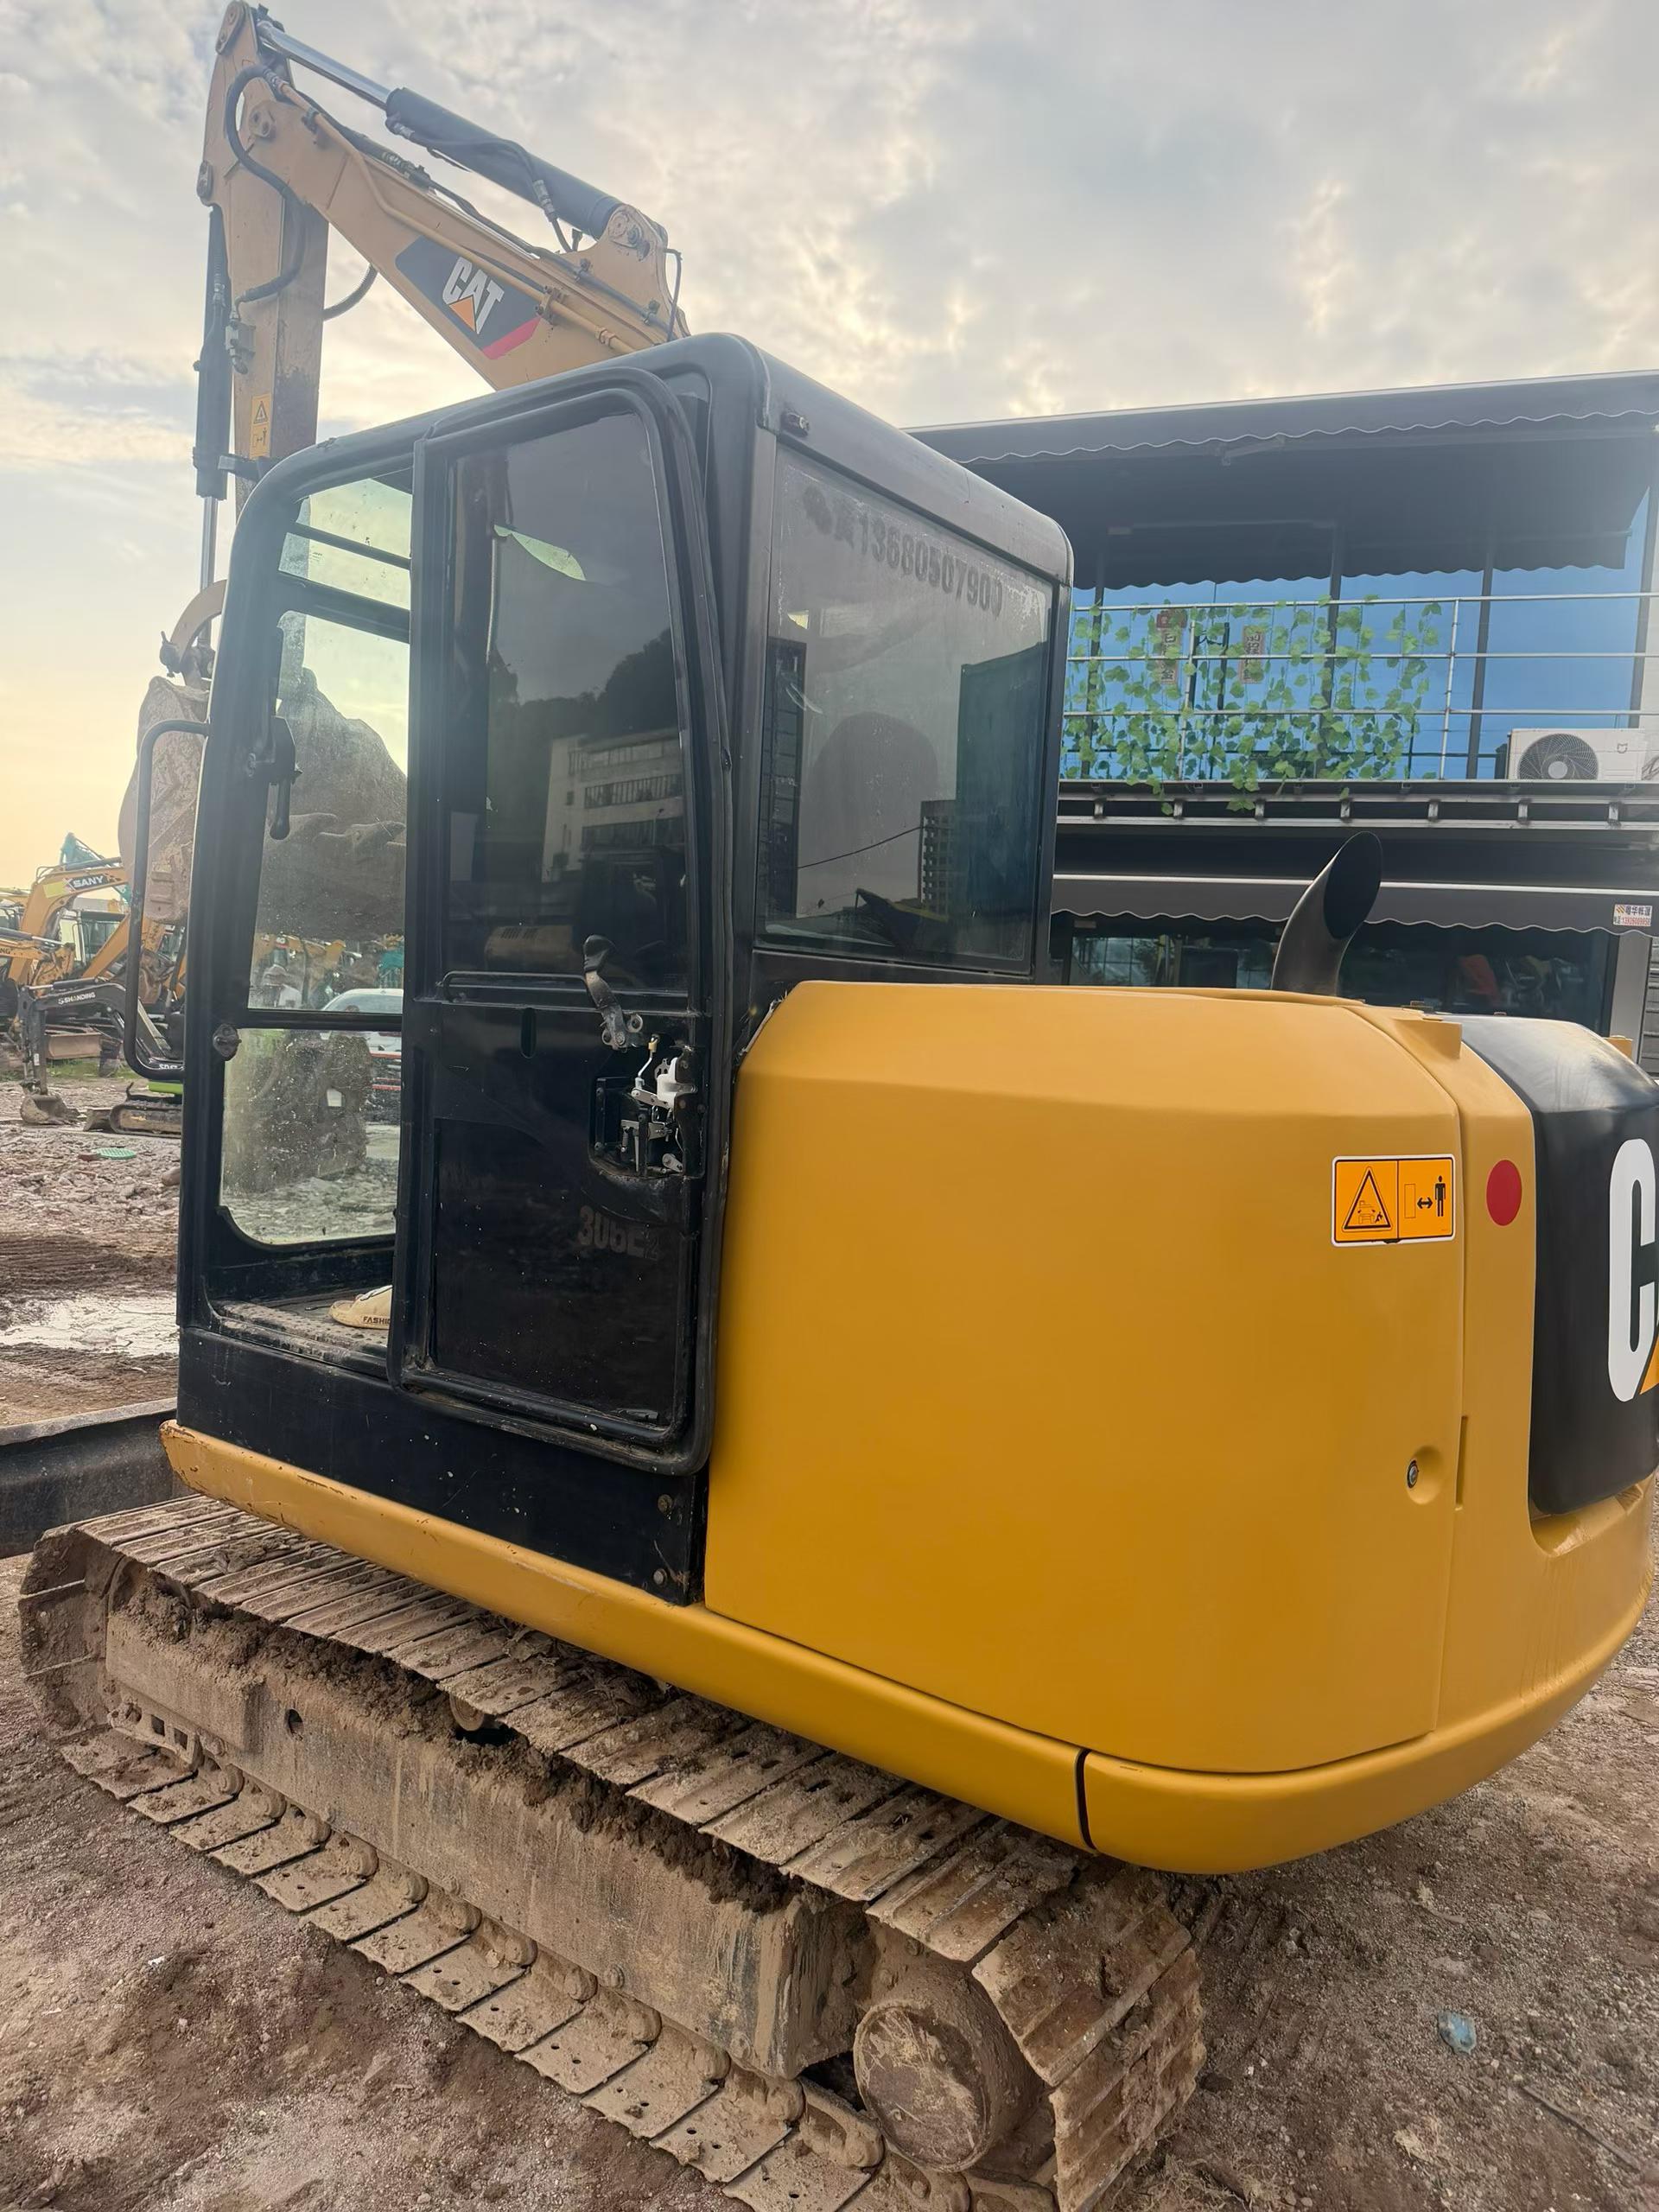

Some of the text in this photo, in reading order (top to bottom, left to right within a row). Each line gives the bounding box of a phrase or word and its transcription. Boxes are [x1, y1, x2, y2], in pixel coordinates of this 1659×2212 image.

[442, 257, 505, 334] CAT
[73, 875, 104, 888] SANY
[1608, 1138, 1659, 1402] C
